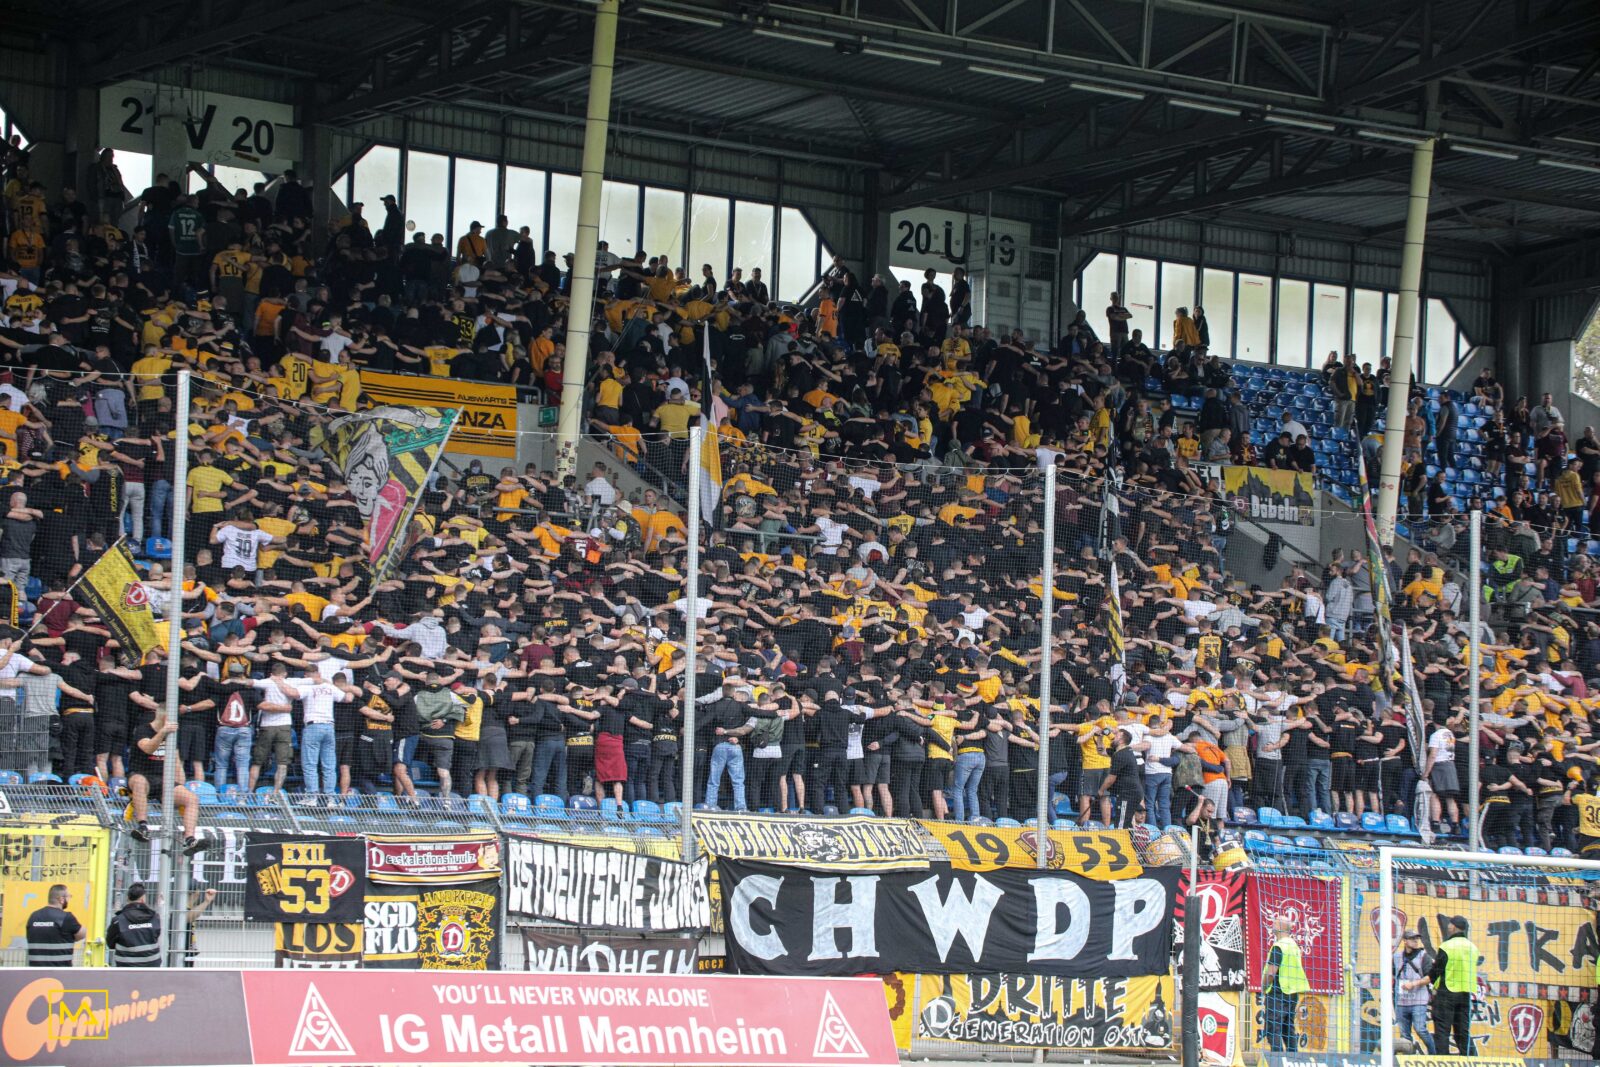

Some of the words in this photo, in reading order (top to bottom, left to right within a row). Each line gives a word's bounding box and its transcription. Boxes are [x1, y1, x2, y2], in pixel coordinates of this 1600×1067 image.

[232, 116, 275, 156] 20
[897, 219, 931, 255] 20
[292, 362, 306, 383] 20
[281, 843, 332, 866] EXIL
[696, 819, 803, 859] OSTBLOCK
[834, 824, 924, 860] DYNAMO
[947, 831, 1010, 866] 19
[1072, 835, 1129, 873] 53
[279, 868, 331, 914] 53
[417, 889, 496, 911] LANDKREIS
[508, 837, 648, 929] OSTDEUTSCHE
[649, 857, 710, 930] JUNGS
[363, 901, 417, 928] SGD
[363, 927, 418, 954] FLO
[527, 941, 697, 974] WALDHEIM
[509, 987, 576, 1005] NEVER
[579, 987, 643, 1006] WORK
[645, 989, 709, 1007] ALONE
[967, 973, 1129, 1019] DRITTE
[379, 1013, 430, 1053] IG
[441, 1014, 568, 1053] Metall
[578, 1016, 787, 1054] Mannheim
[949, 1019, 1095, 1047] GENERATION
[1103, 1025, 1146, 1049] OST
